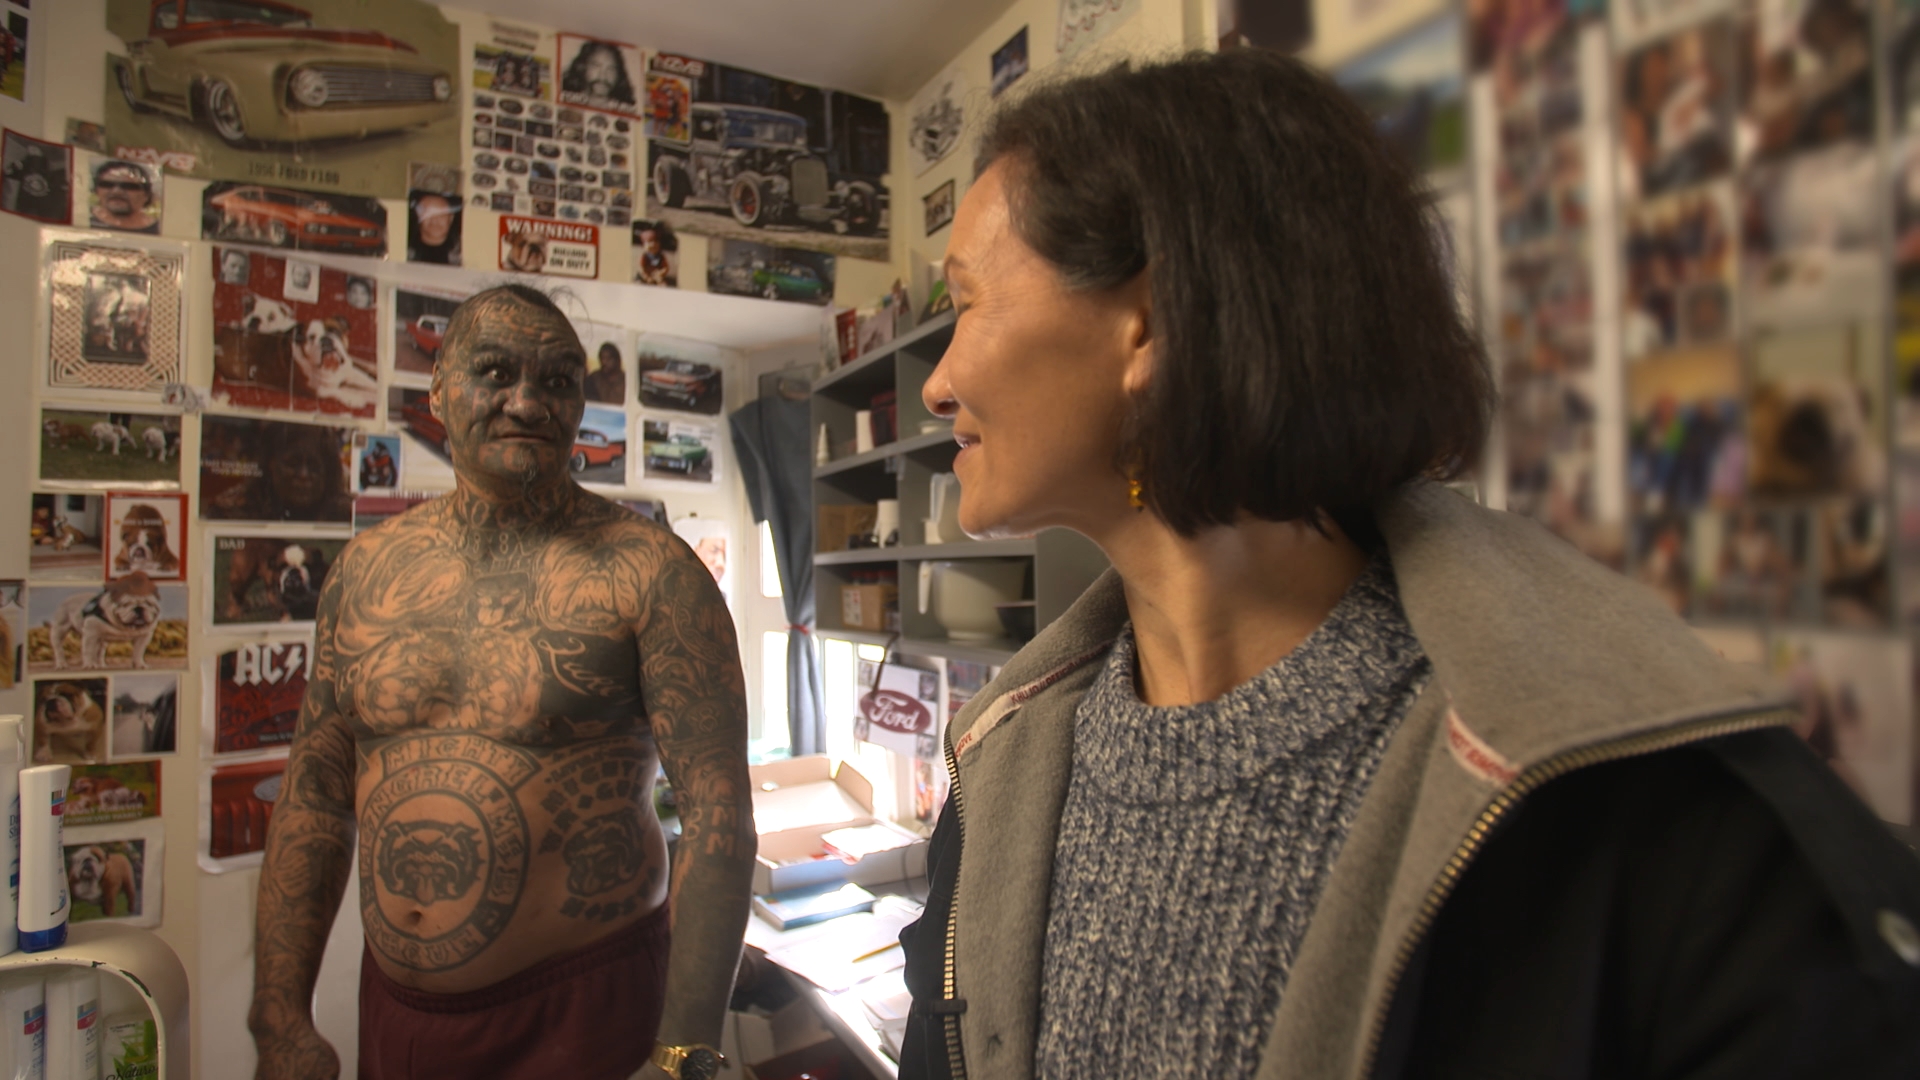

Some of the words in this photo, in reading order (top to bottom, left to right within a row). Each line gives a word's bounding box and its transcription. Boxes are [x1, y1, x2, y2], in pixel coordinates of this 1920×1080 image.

[506, 218, 593, 242] WARNING!
[550, 257, 564, 268] ON
[566, 259, 591, 270] DUTY
[219, 539, 246, 551] DAD
[869, 693, 921, 731] Ford
[385, 737, 530, 786] MIGHTY
